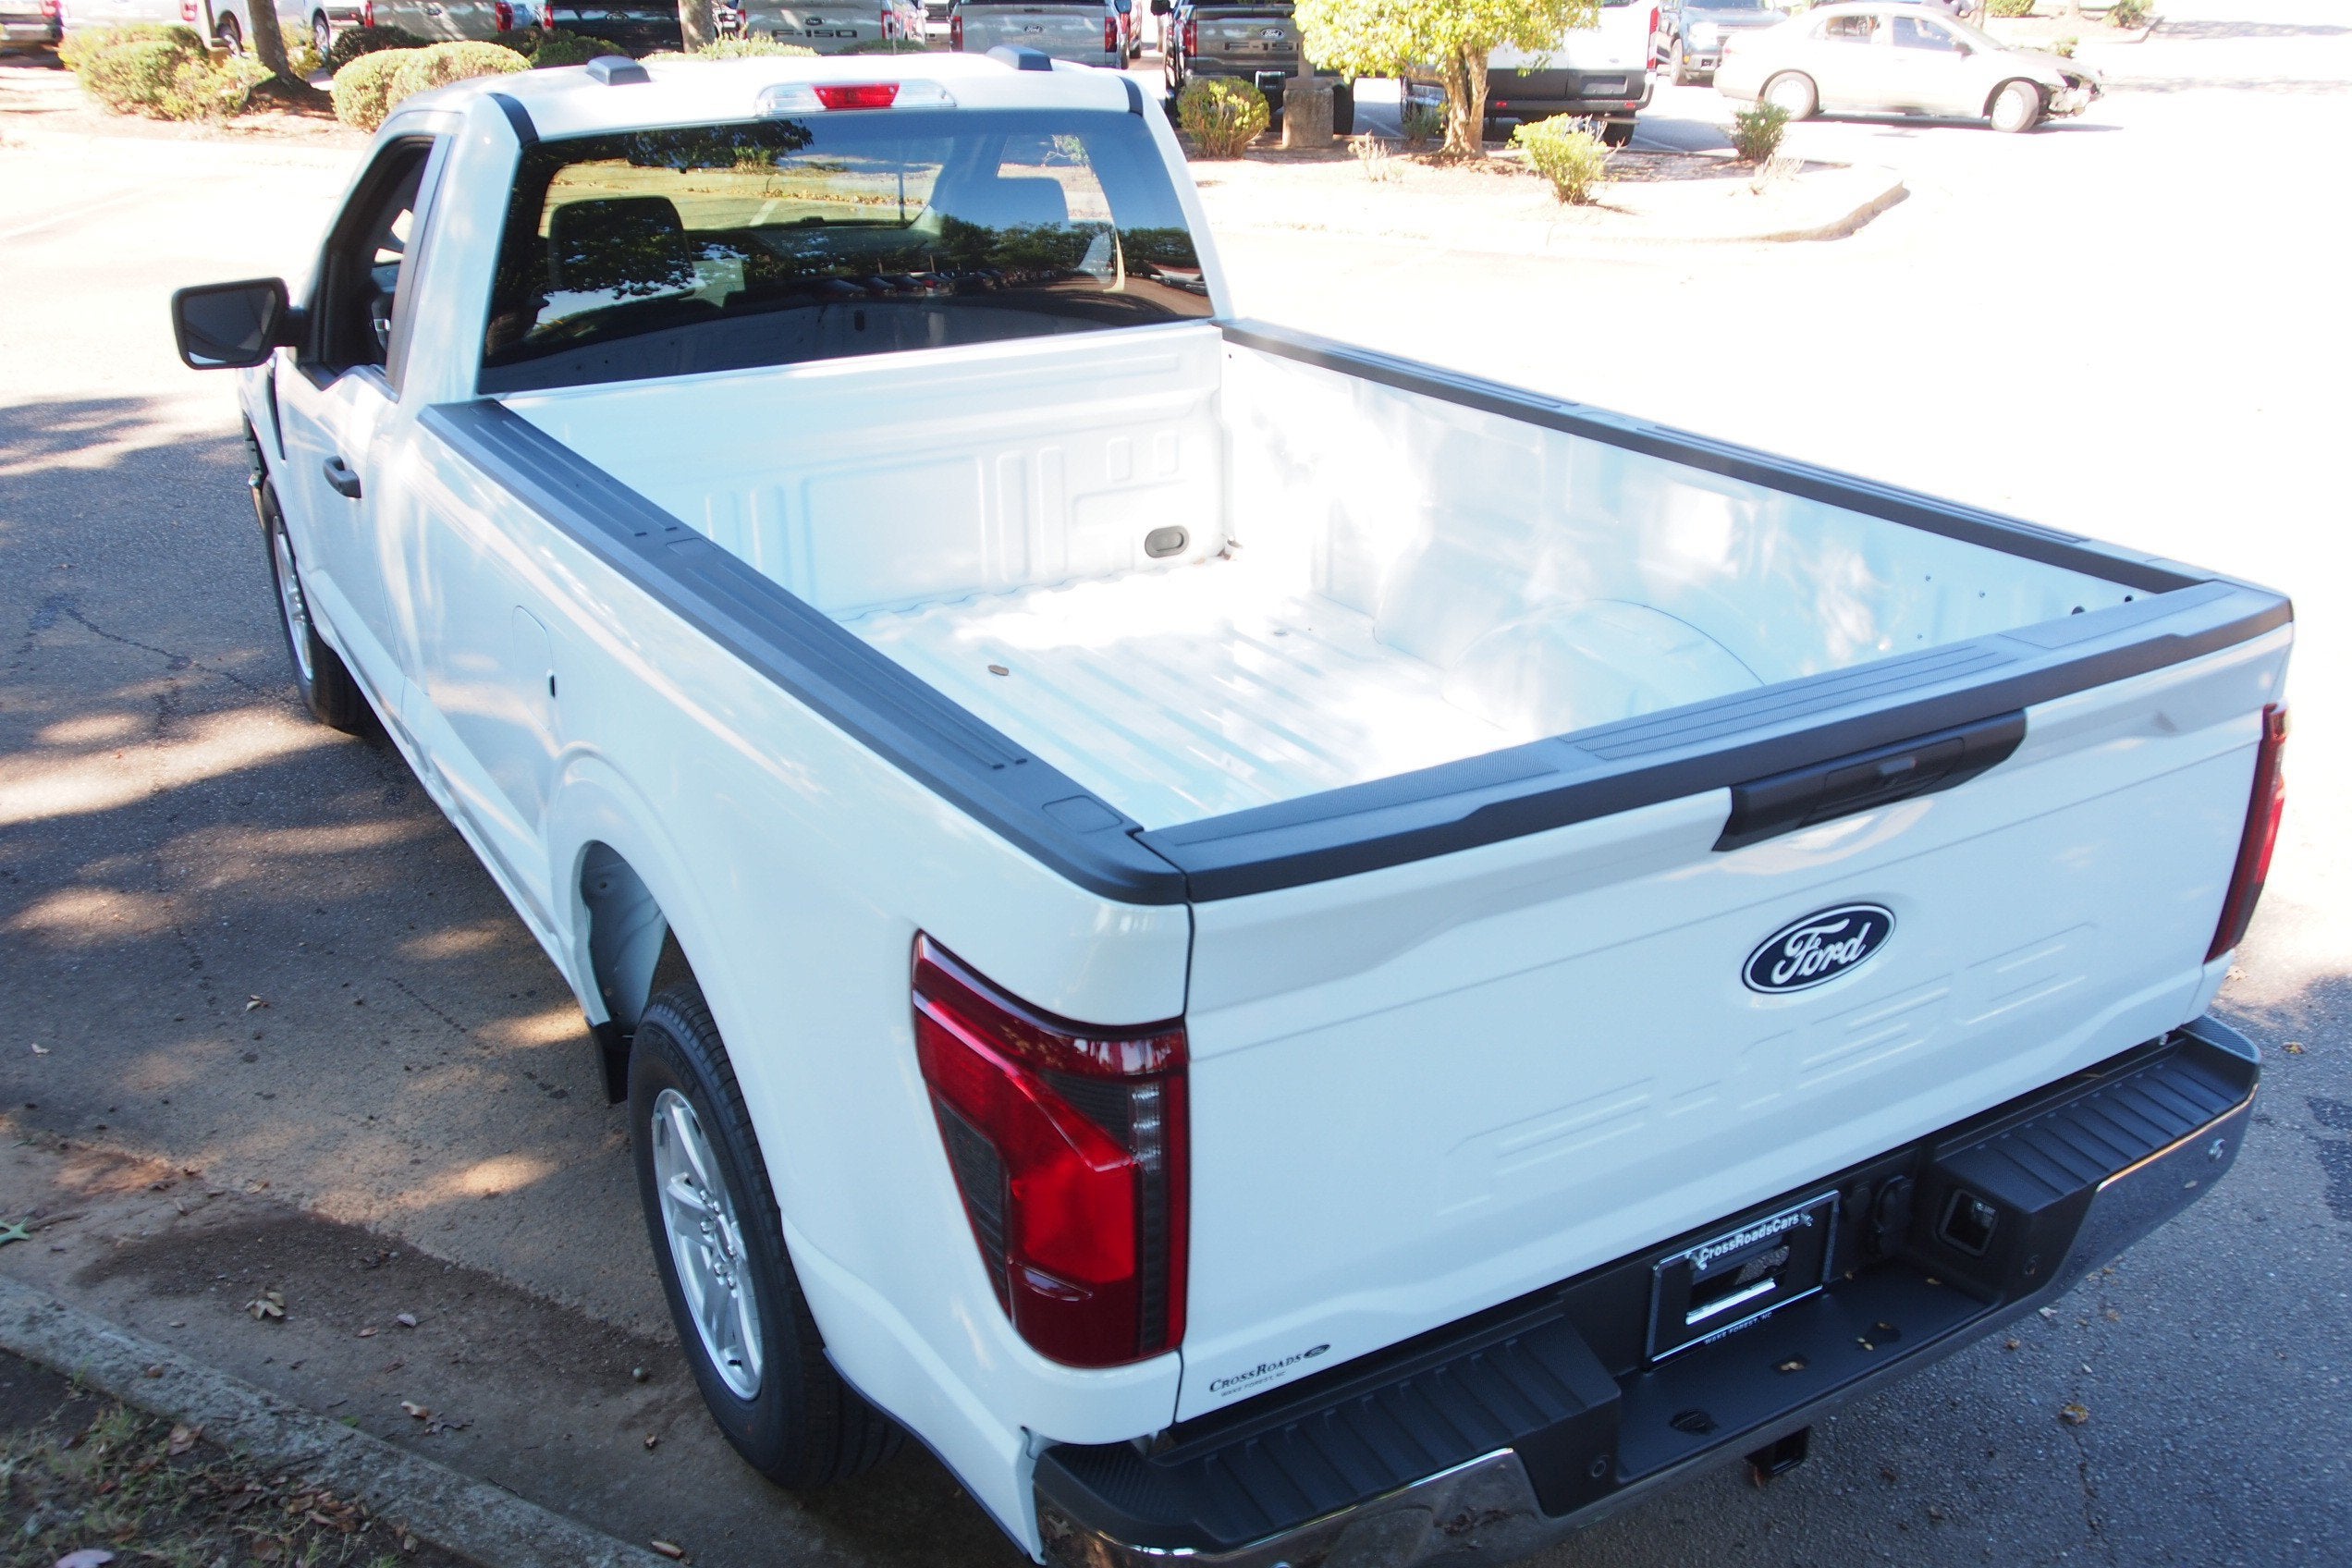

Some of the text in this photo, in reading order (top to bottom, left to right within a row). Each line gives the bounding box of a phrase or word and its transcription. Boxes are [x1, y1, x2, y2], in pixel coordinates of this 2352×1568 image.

[771, 29, 858, 38] F-150
[1225, 42, 1300, 51] F-15
[1770, 918, 1872, 985] Ford
[1699, 1213, 1799, 1261] CrossRoadsCars
[1705, 1331, 1727, 1345] WAKE
[1761, 1312, 1772, 1320] NC
